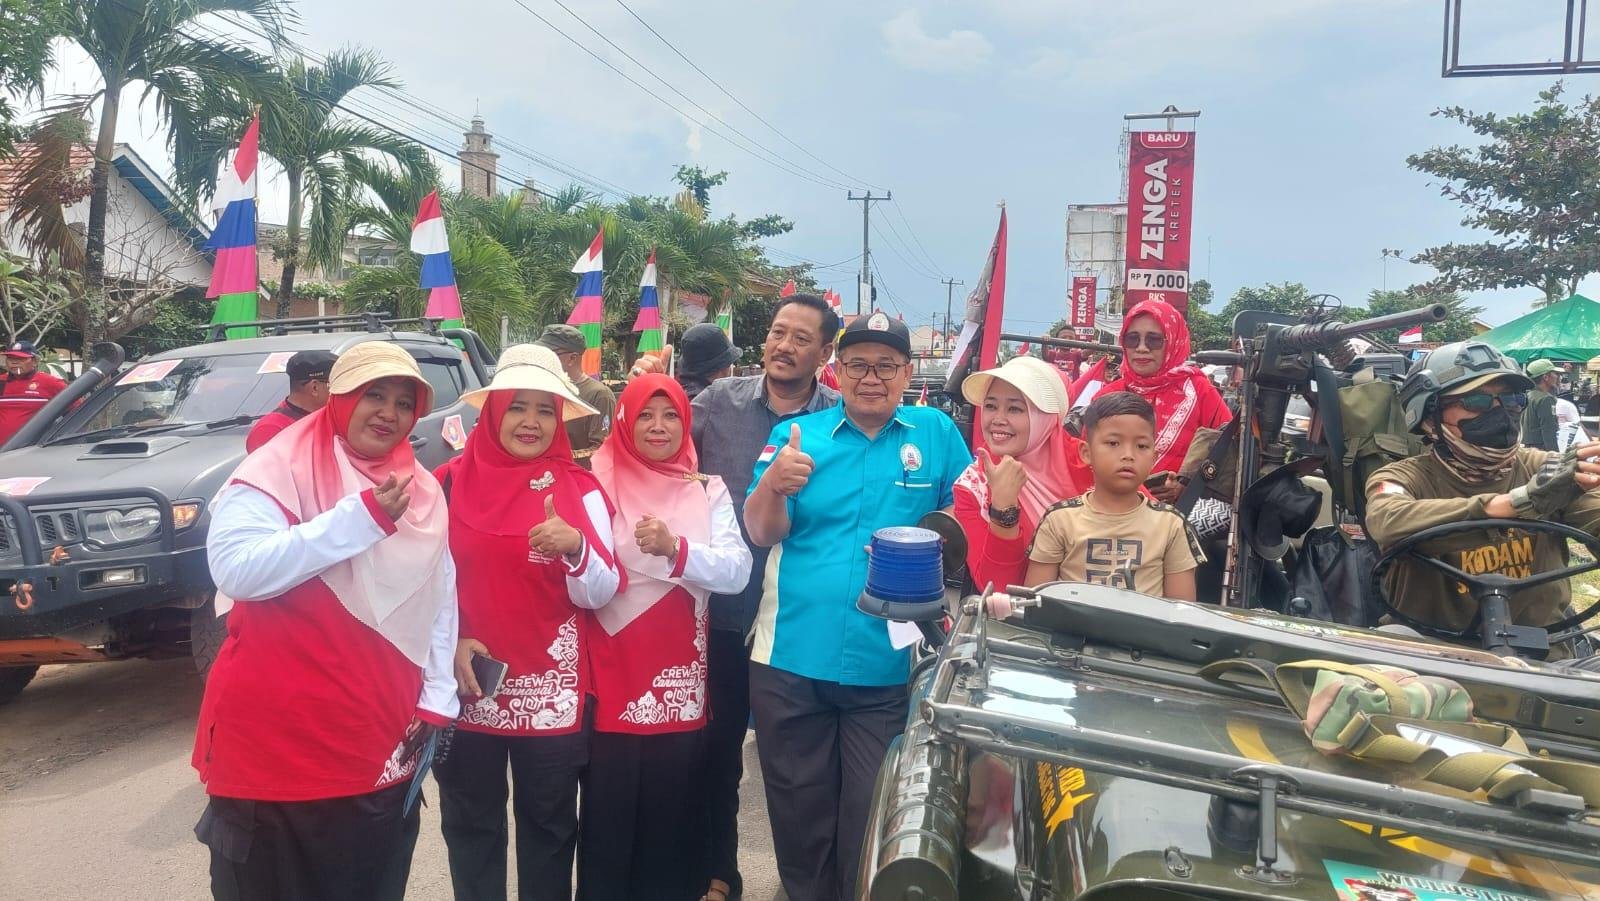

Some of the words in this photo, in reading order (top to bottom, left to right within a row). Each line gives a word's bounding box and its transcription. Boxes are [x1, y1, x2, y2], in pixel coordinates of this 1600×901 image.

[1147, 132, 1181, 143] BARU
[1139, 158, 1168, 260] ZENGA
[1169, 177, 1183, 241] KRETEK
[1130, 272, 1142, 281] RP
[1143, 273, 1185, 289] 7.000
[1460, 536, 1534, 575] KODAM
[661, 668, 691, 679] CREW
[505, 676, 545, 688] CREW
[652, 675, 697, 688] Carnaval
